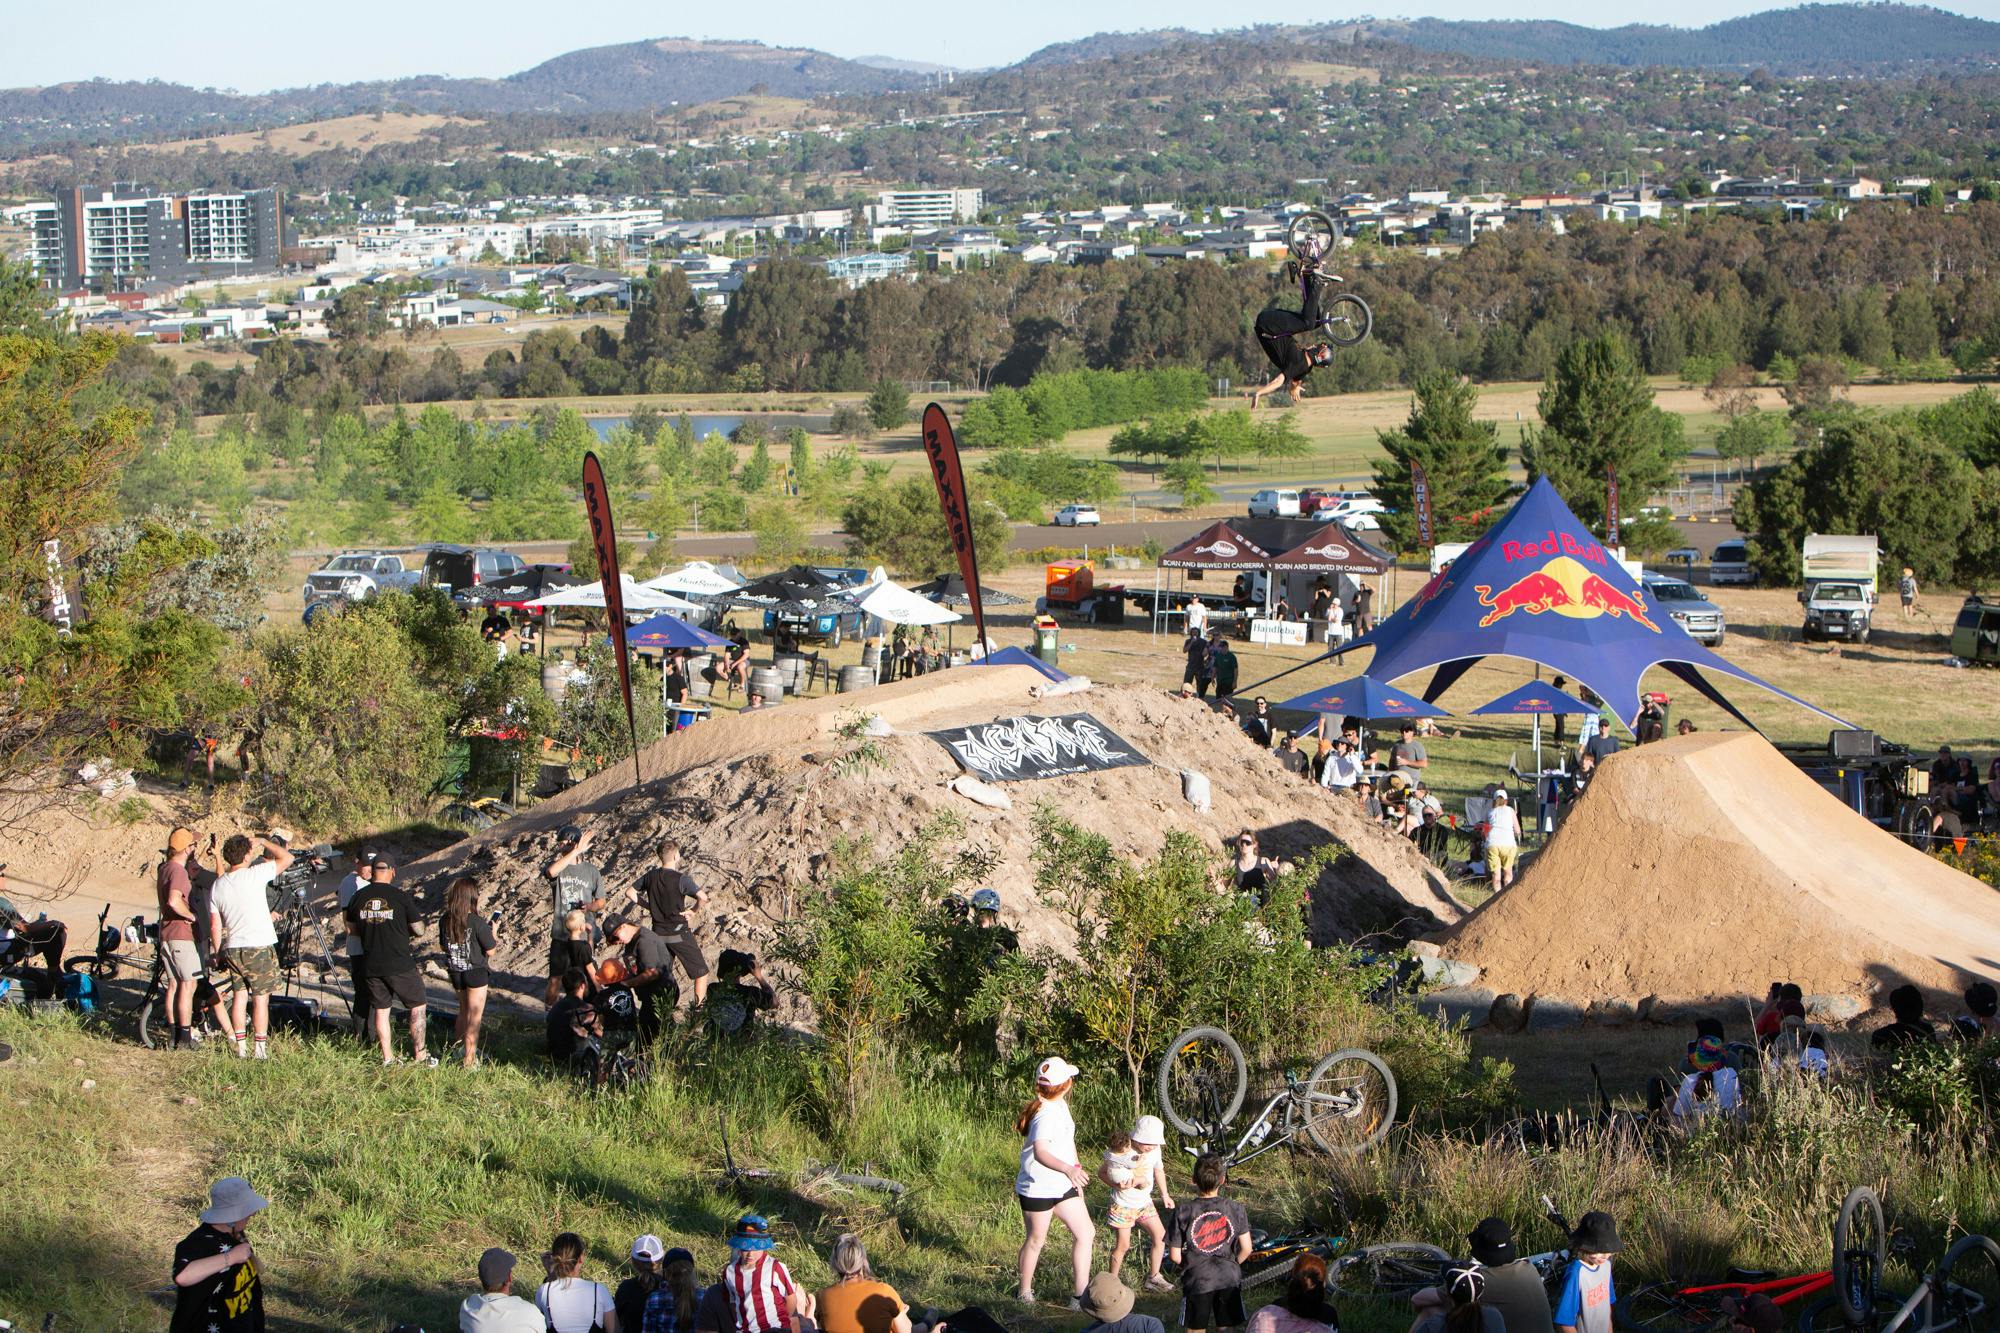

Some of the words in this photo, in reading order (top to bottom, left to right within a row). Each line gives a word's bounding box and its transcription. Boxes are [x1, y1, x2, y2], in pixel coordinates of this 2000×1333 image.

[926, 429, 967, 553] MAXXIS
[1416, 484, 1430, 541] DRINKS
[1163, 559, 1181, 567] BORN
[1181, 560, 1196, 568] AND
[1501, 530, 1560, 563] Red
[1559, 532, 1608, 567] Bull
[1344, 565, 1378, 573] CANBERRA
